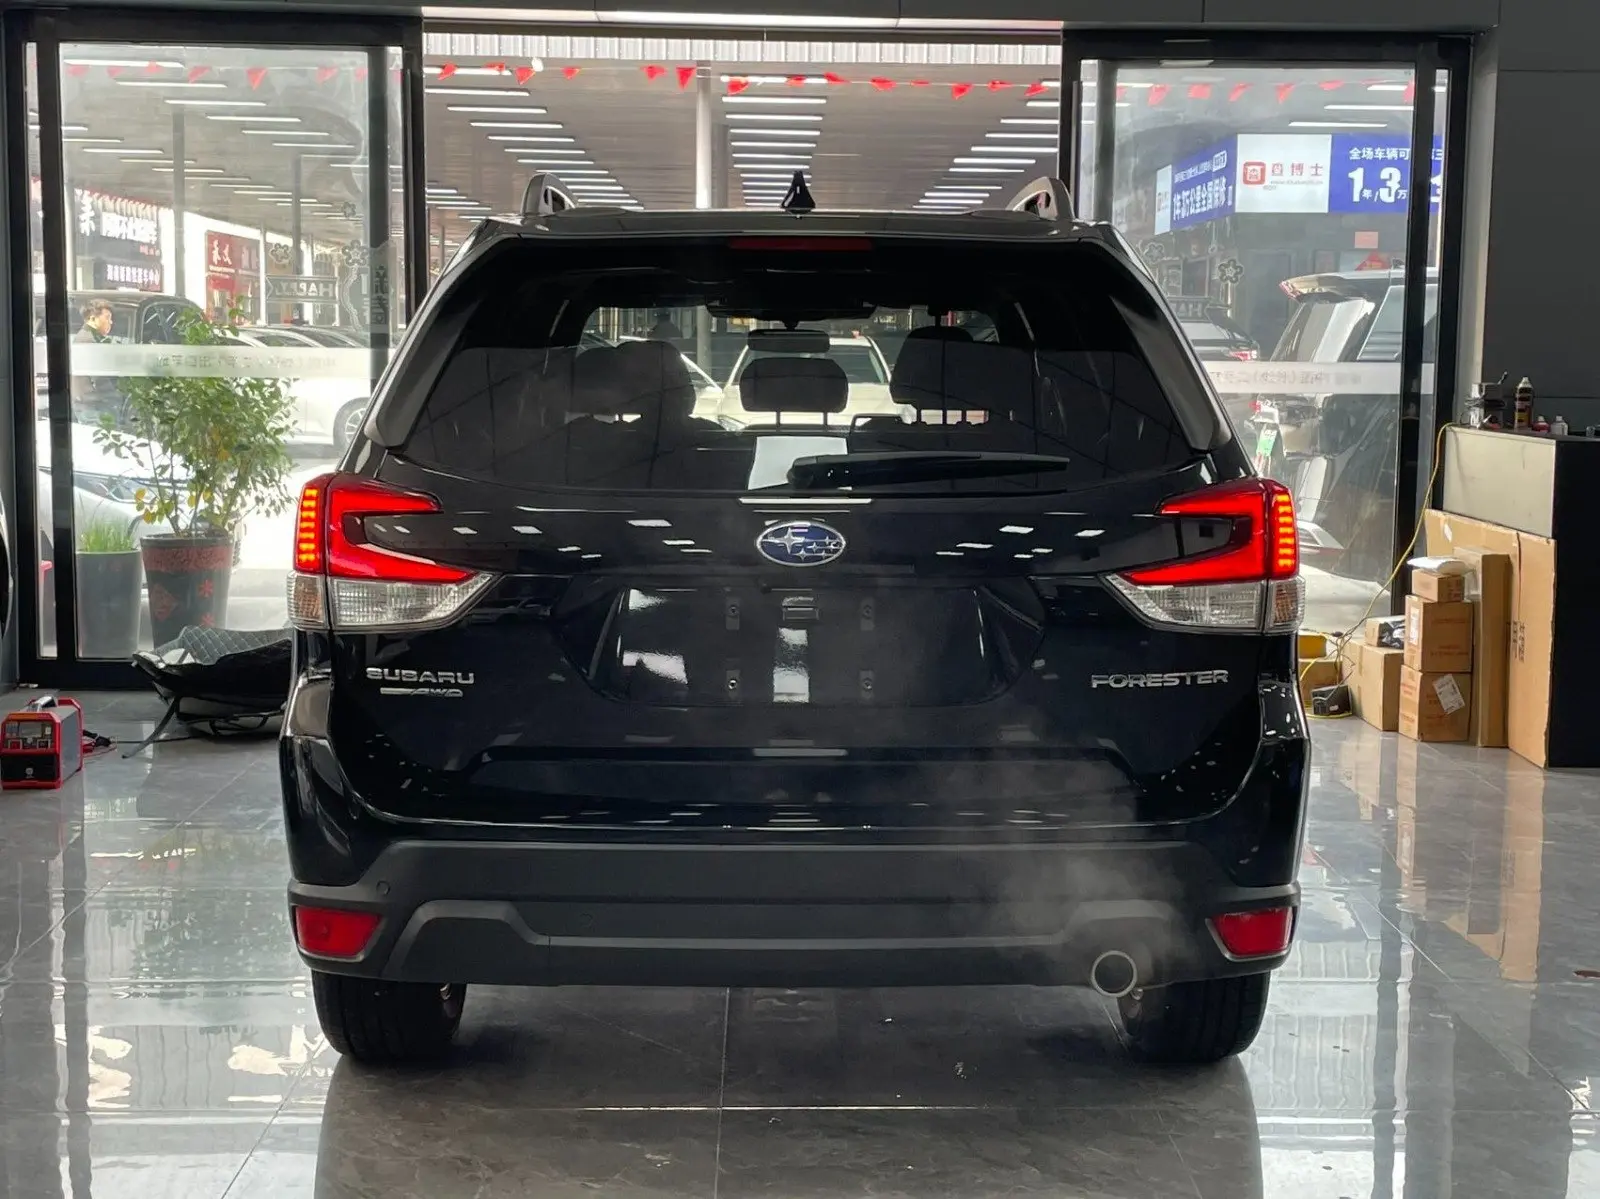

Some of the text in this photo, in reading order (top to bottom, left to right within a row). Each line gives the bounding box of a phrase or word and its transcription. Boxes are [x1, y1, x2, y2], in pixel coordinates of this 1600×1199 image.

[1349, 147, 1411, 160] 全场车辆可
[366, 667, 474, 684] SUBARU
[1091, 669, 1229, 688] FORESTER
[411, 687, 464, 698] AWD
